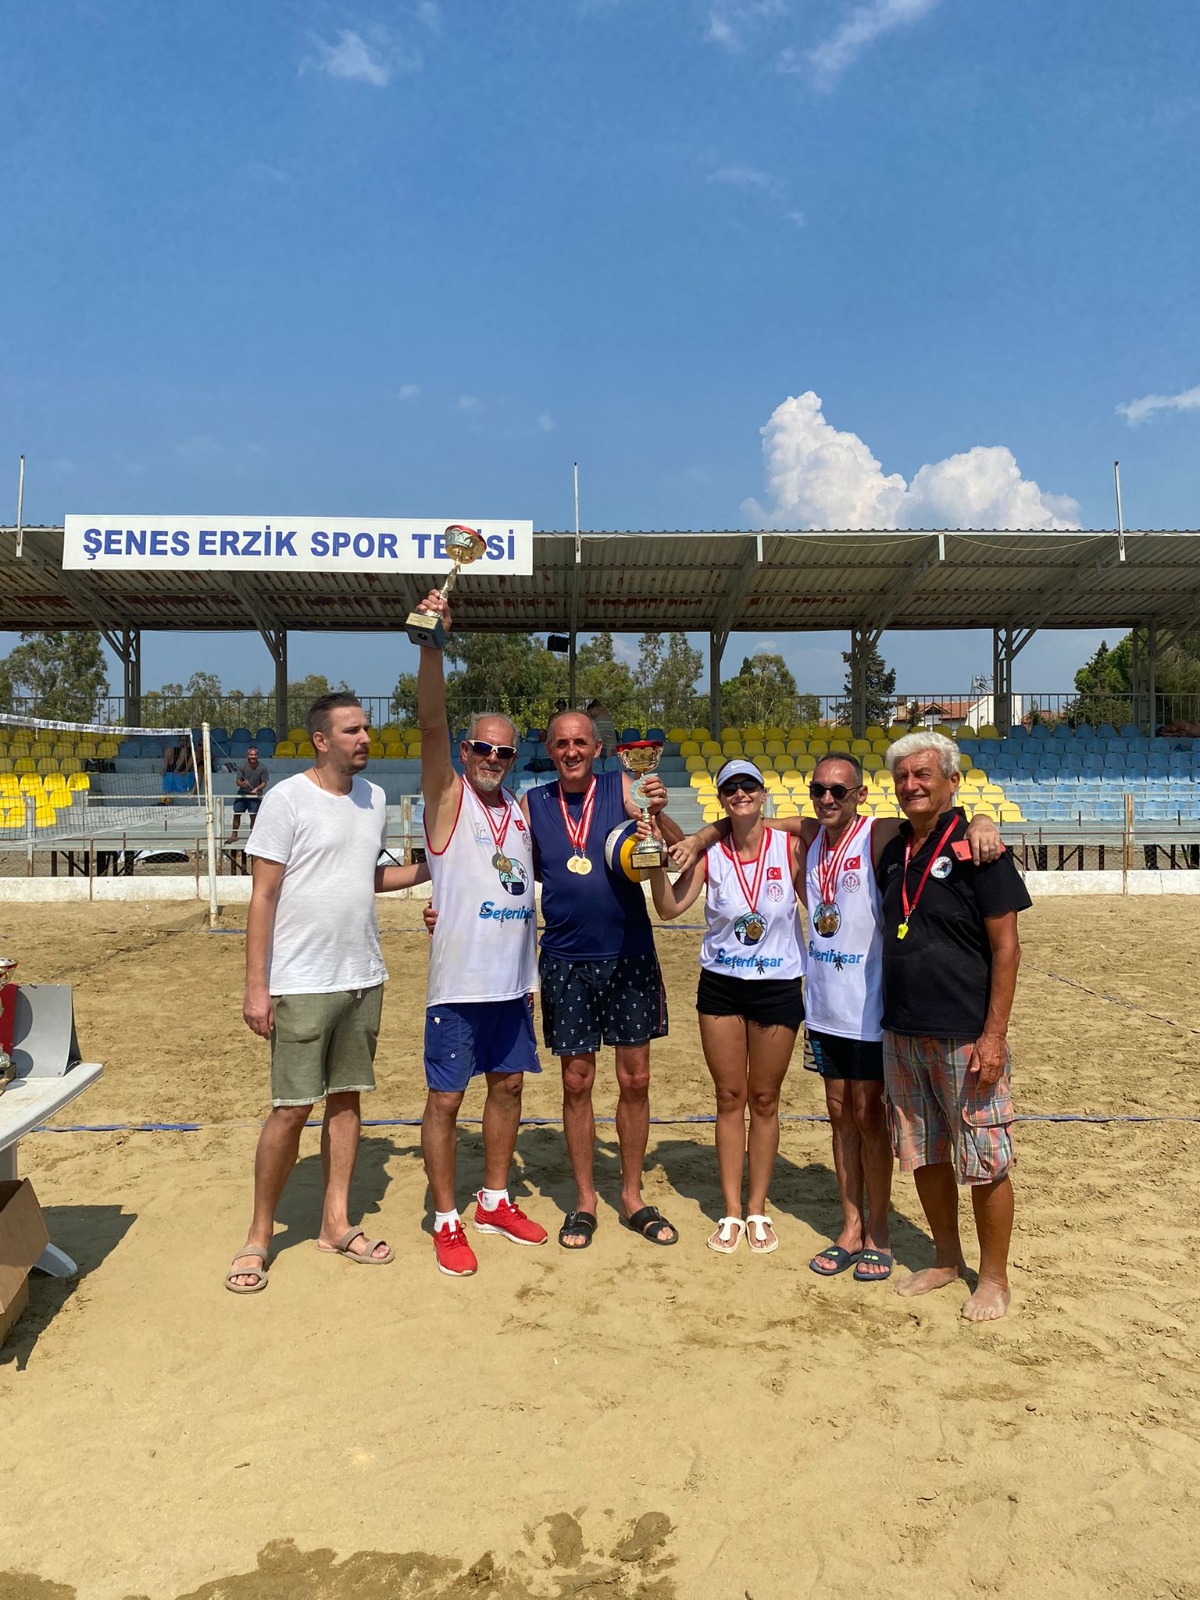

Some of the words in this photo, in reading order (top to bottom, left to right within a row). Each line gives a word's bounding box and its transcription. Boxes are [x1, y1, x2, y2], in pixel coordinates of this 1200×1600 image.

[83, 529, 190, 560] ŞENES
[199, 525, 298, 556] ERZİK
[310, 531, 398, 558] SPOR
[411, 529, 515, 560] TESİ
